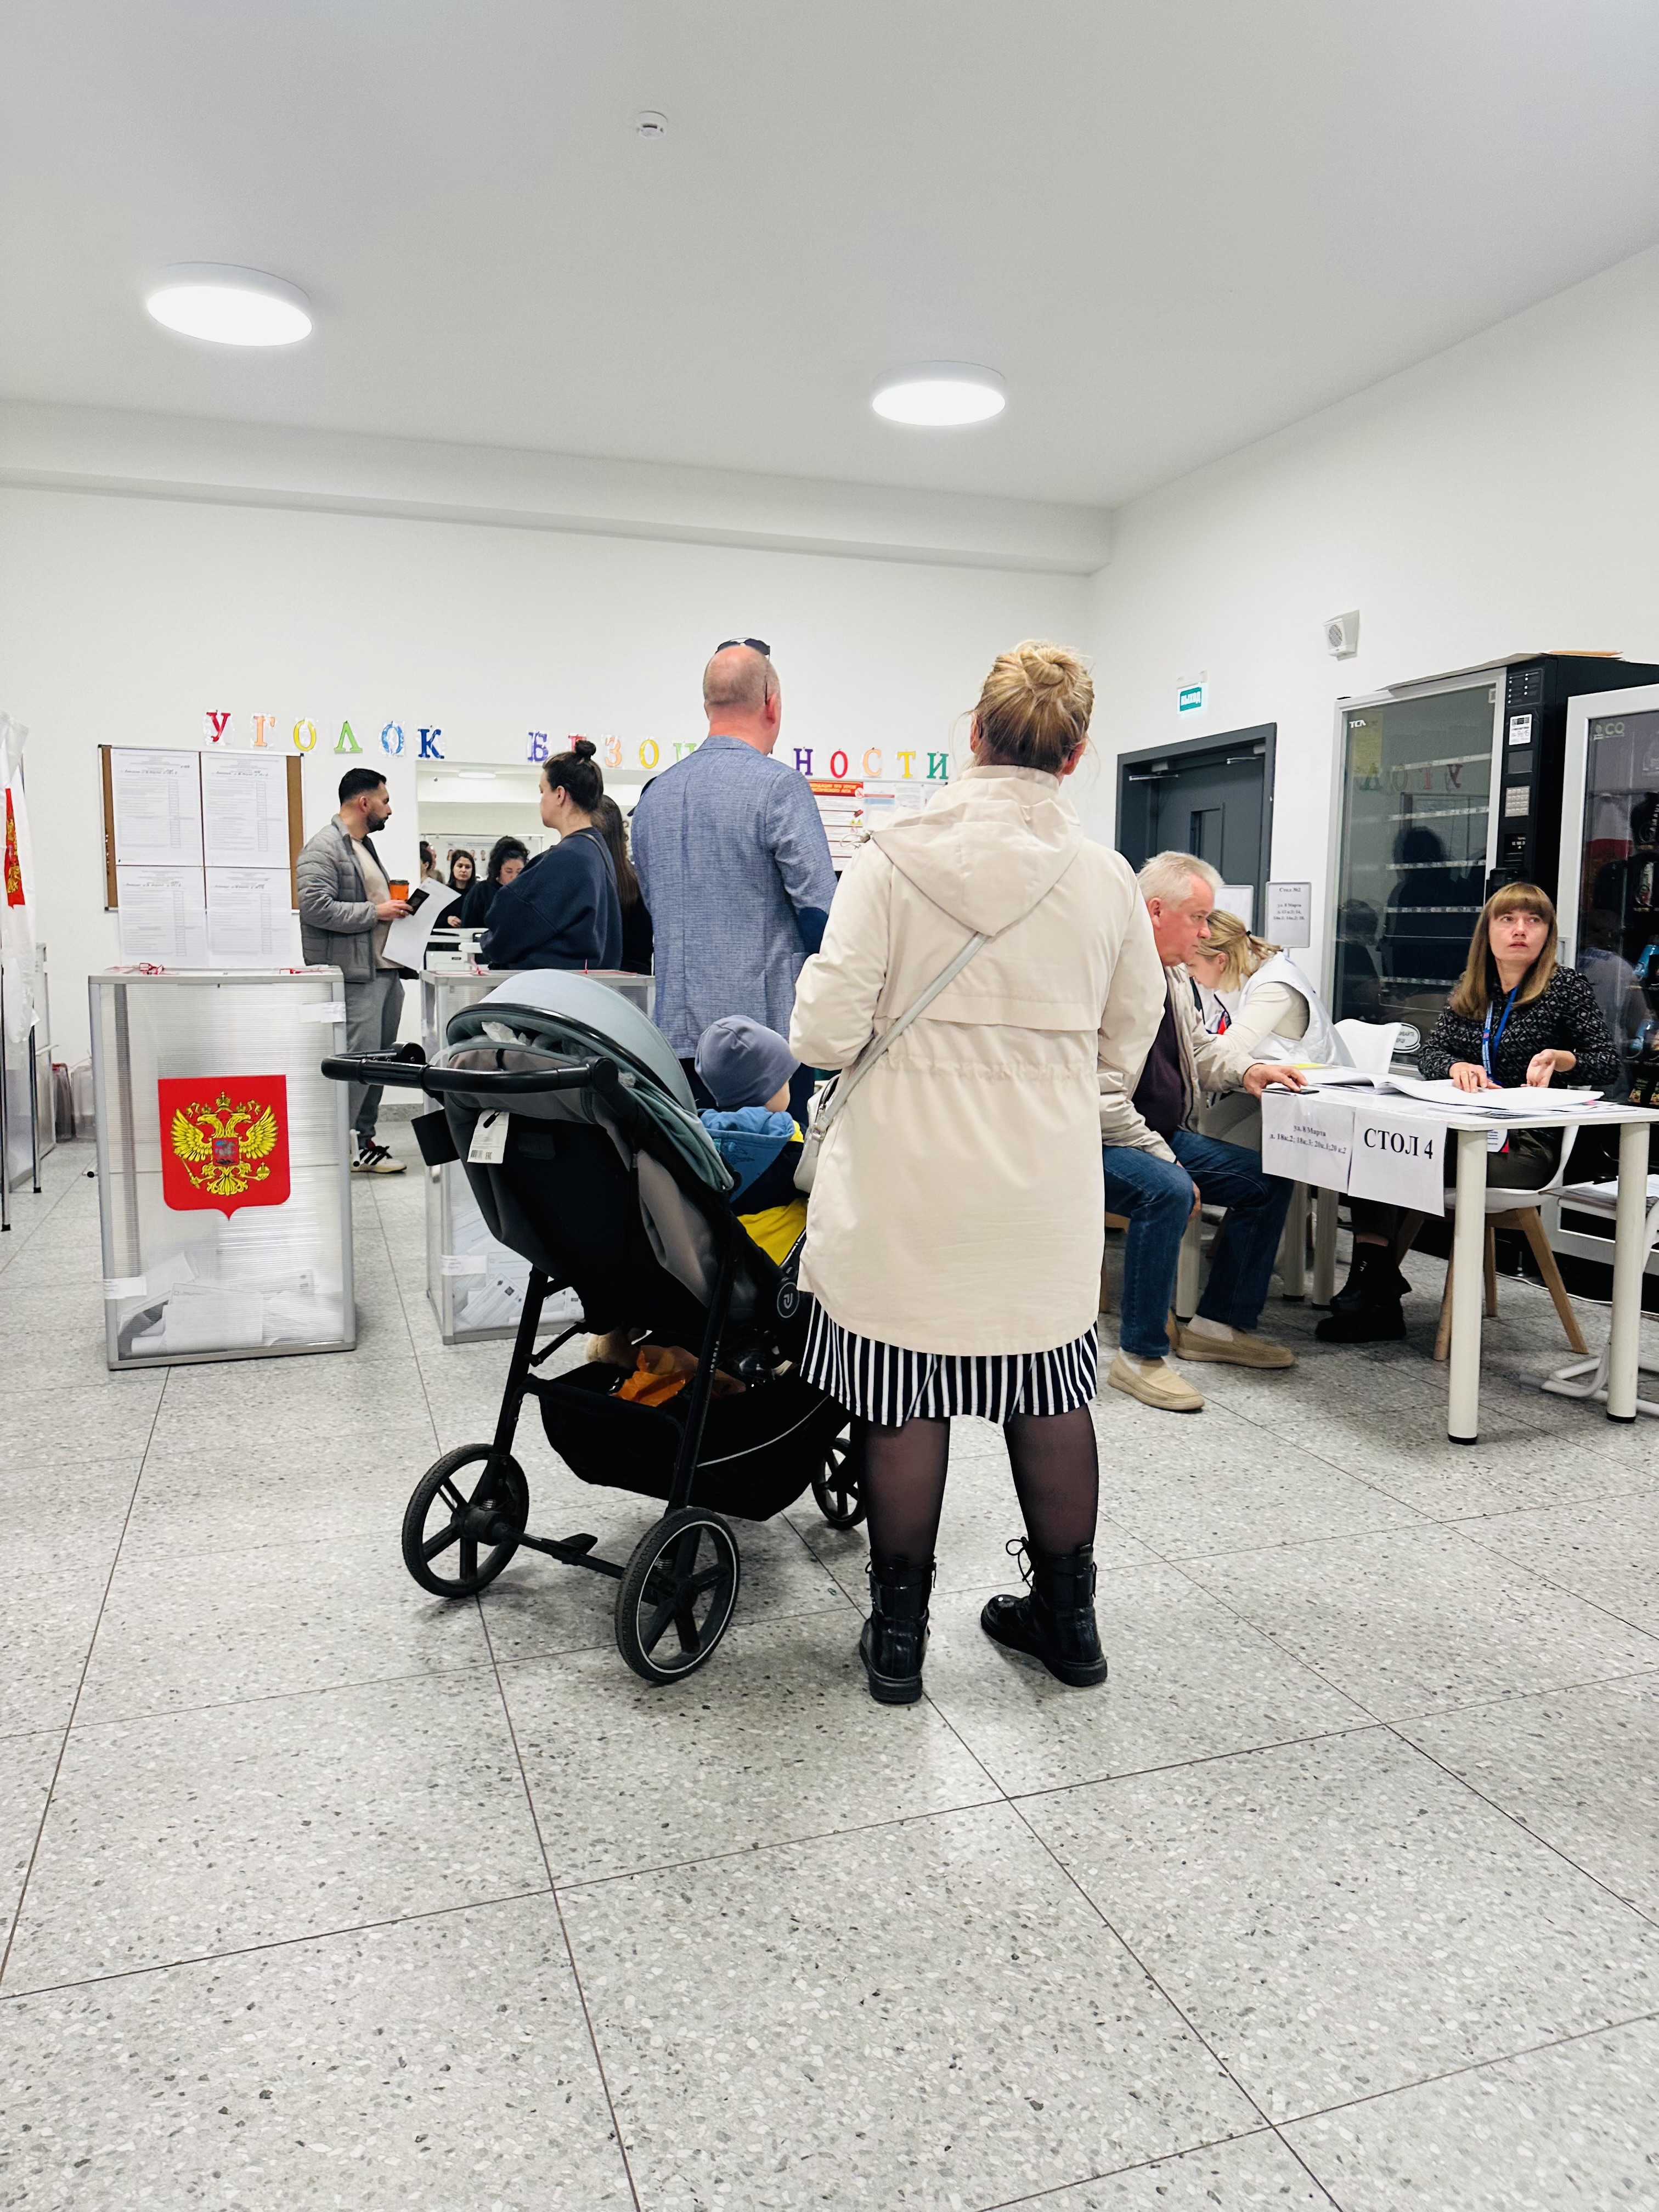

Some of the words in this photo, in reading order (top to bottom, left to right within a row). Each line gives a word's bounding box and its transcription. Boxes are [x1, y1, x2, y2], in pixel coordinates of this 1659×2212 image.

[206, 712, 444, 759] УГОЛОК
[1307, 1127, 1326, 1136] Марта
[1364, 1128, 1419, 1156] СТОЛ
[1424, 1139, 1433, 1159] 4
